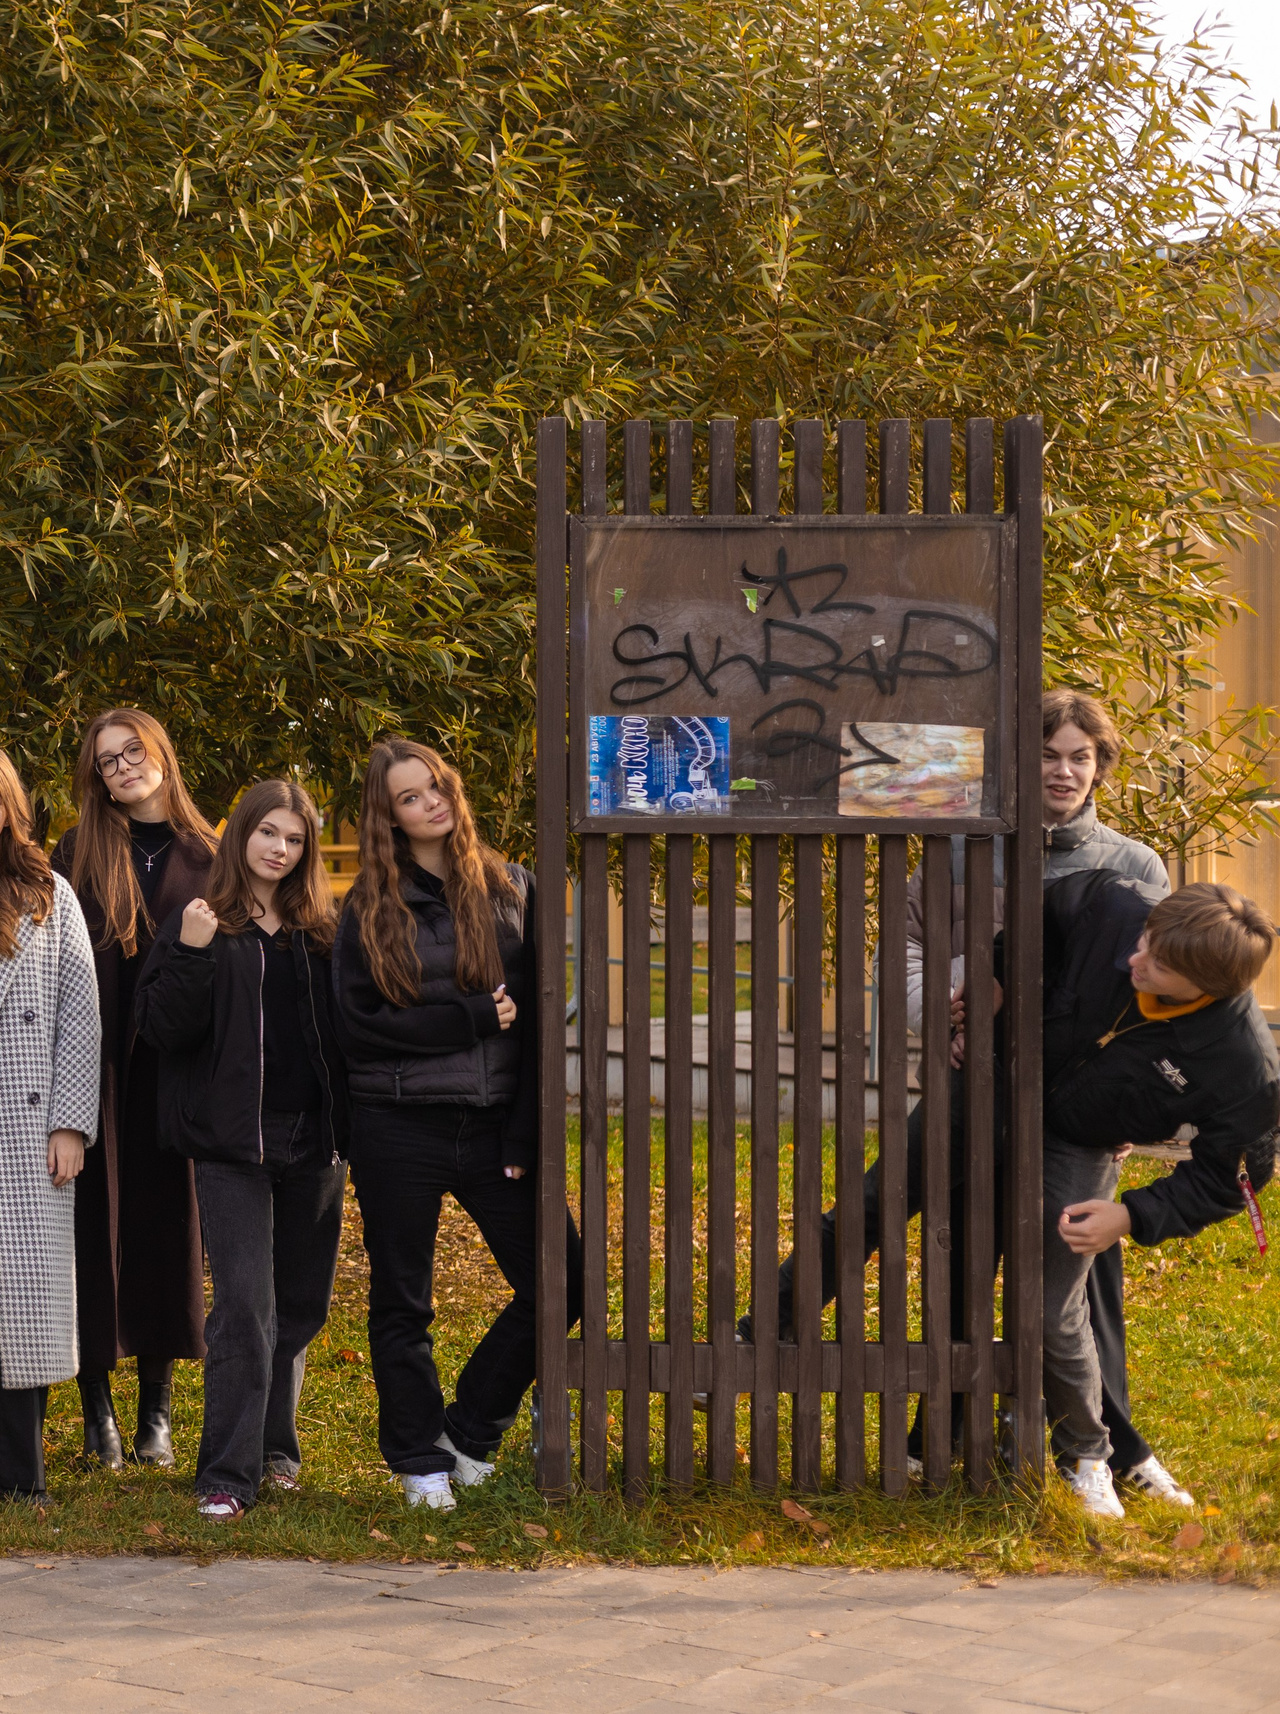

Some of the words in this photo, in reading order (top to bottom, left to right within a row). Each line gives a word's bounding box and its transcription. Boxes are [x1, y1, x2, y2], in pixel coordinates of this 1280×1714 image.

[591, 716, 599, 752] АВГУСТА
[599, 716, 607, 738] 17:00
[592, 753, 599, 763] 23
